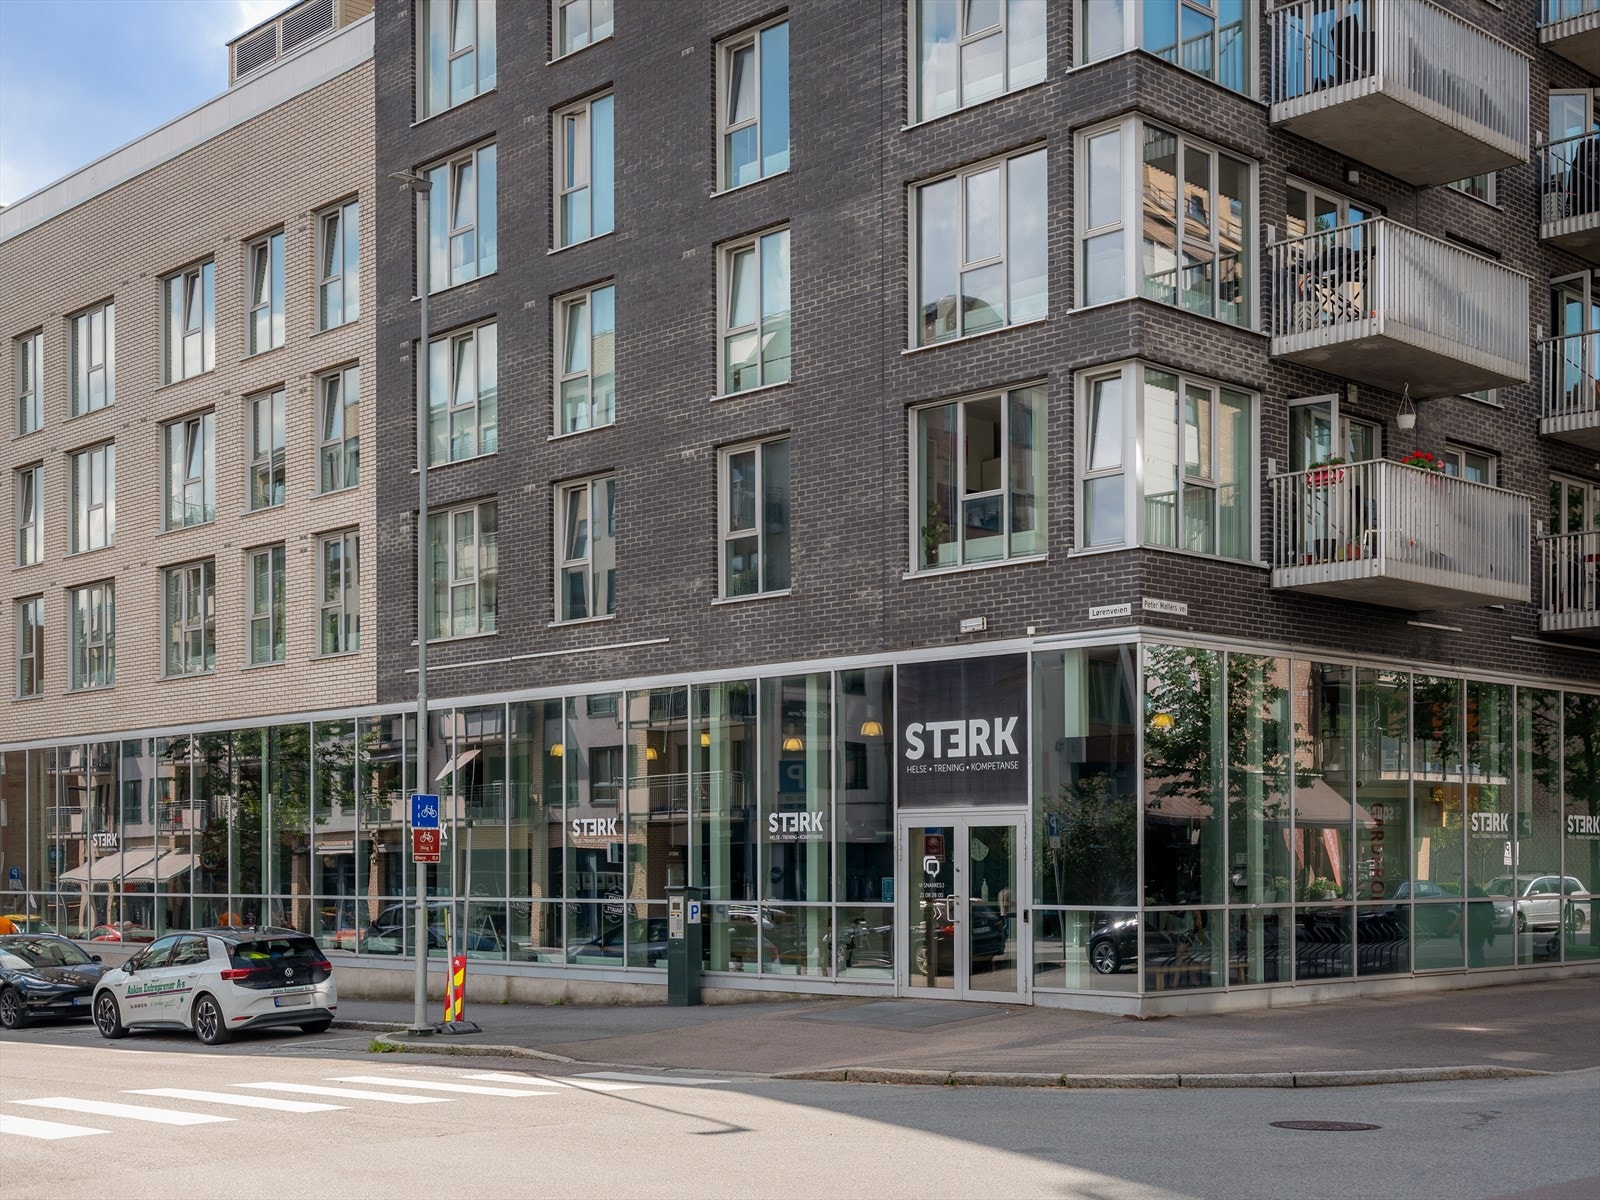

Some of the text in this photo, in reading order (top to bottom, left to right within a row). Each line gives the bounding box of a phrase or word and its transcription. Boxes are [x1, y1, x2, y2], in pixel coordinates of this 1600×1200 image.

[1092, 606, 1128, 616] Lørenveien
[1144, 600, 1158, 608] Peter
[1179, 605, 1187, 613] vei
[906, 760, 1019, 774] HELSE TRENING KOMPETANSE
[691, 904, 699, 920] P
